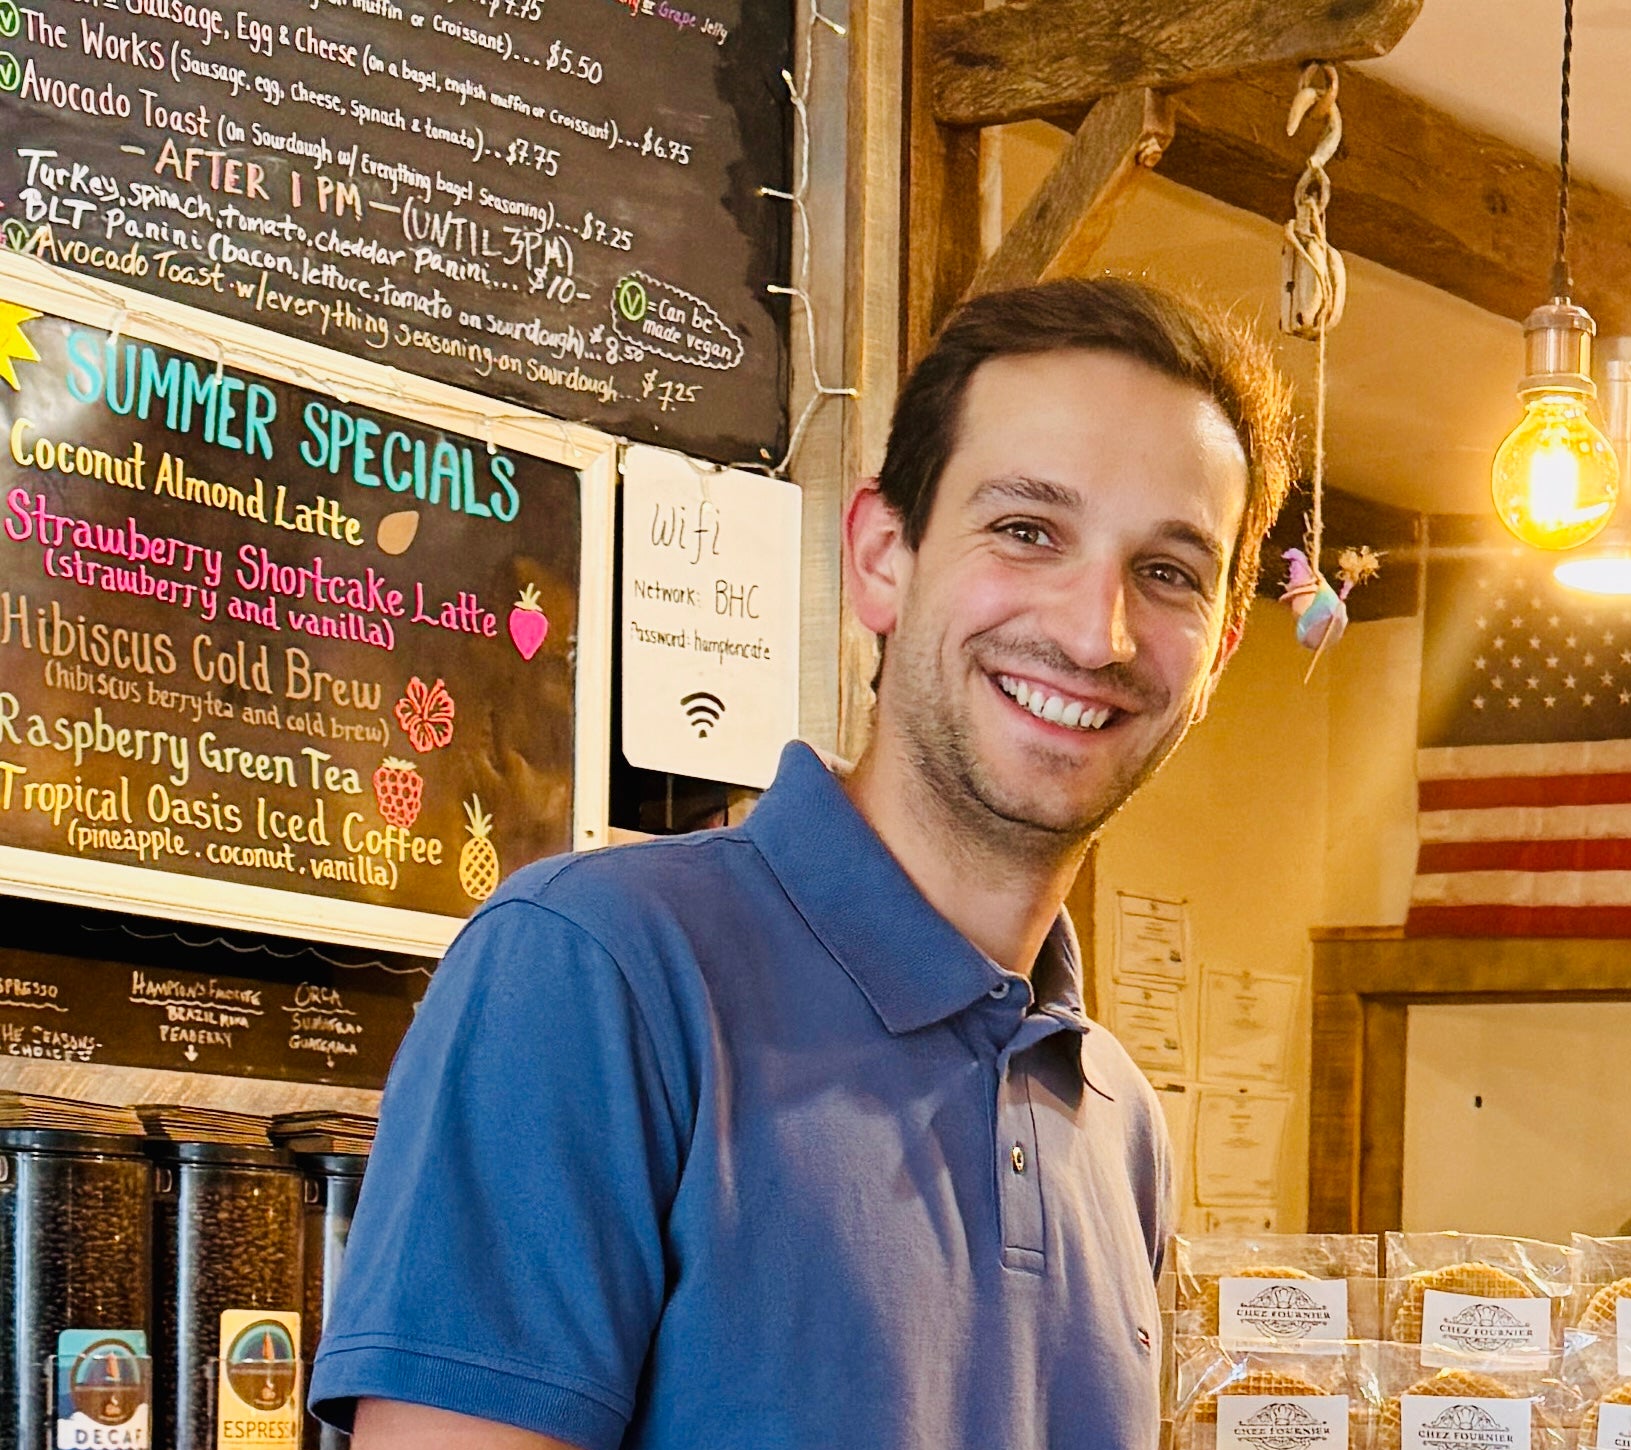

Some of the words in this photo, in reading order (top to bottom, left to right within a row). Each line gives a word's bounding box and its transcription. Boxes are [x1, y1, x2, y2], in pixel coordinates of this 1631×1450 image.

[546, 39, 603, 84] $5.50
[658, 1, 696, 31] Grape
[700, 17, 729, 46] Jelly
[18, 6, 69, 49] The
[80, 17, 166, 72] Works
[169, 39, 251, 97] (Sausage,
[253, 74, 285, 107] egg,
[410, 116, 421, 133] &
[505, 137, 561, 177] $7.75
[236, 11, 273, 57] Egg
[278, 24, 291, 46] &
[294, 25, 358, 68] Cheese
[388, 62, 399, 78] a
[444, 76, 487, 106] english
[531, 105, 546, 119] or
[640, 126, 693, 166] $6.75
[19, 57, 131, 119] Avocado
[138, 87, 212, 138] Toast
[250, 122, 333, 170] Sourdough
[337, 143, 359, 177] w/
[580, 210, 635, 251] $7.25
[154, 137, 270, 201] AFTER
[402, 195, 503, 257] (UNTIL
[502, 225, 574, 277] 3PM)
[313, 228, 407, 266] cheddar
[18, 187, 98, 230] BLT
[104, 207, 204, 251] Panini
[376, 276, 453, 319] tomato
[458, 309, 483, 330] on
[588, 323, 645, 365] $8.50
[36, 222, 150, 279] Avocado
[152, 251, 225, 293] Toast
[641, 368, 703, 412] $7.25
[690, 307, 714, 335] be
[641, 317, 683, 345] made
[685, 334, 733, 362] vegan
[65, 331, 278, 461] SUMMER
[300, 401, 521, 523] SPECIALS
[10, 417, 146, 491] Coconut
[154, 451, 268, 524] Almond
[274, 484, 365, 546] Latte
[650, 500, 720, 566] Wifi
[4, 487, 223, 588] Strawberry
[235, 543, 406, 617] Shortcake
[410, 581, 498, 638] Latte
[43, 547, 218, 621] (strawberry
[227, 596, 282, 631] and
[287, 609, 395, 651] vanilla)
[714, 579, 760, 620] BHC
[0, 591, 178, 675] Hibiscus
[192, 633, 273, 695] Cold
[285, 646, 382, 711] Brew
[0, 691, 190, 787] Raspberry
[197, 731, 298, 789] Green
[301, 746, 363, 795] Tea
[44, 658, 142, 704] (hibiscus
[147, 680, 203, 723] berry
[203, 690, 235, 719] tea
[241, 704, 282, 731] and
[286, 711, 327, 739] cold
[330, 716, 390, 749] brew)
[0, 760, 133, 827] Tropical
[147, 783, 244, 834] Oasis
[256, 796, 331, 848] Iced
[341, 811, 443, 866] Coffee
[310, 856, 400, 891] vanilla)
[294, 981, 343, 1009] ORCA
[75, 1428, 143, 1446] DECAF
[1418, 1430, 1450, 1440] CHEZ
[1453, 1432, 1514, 1443] FOURNIER
